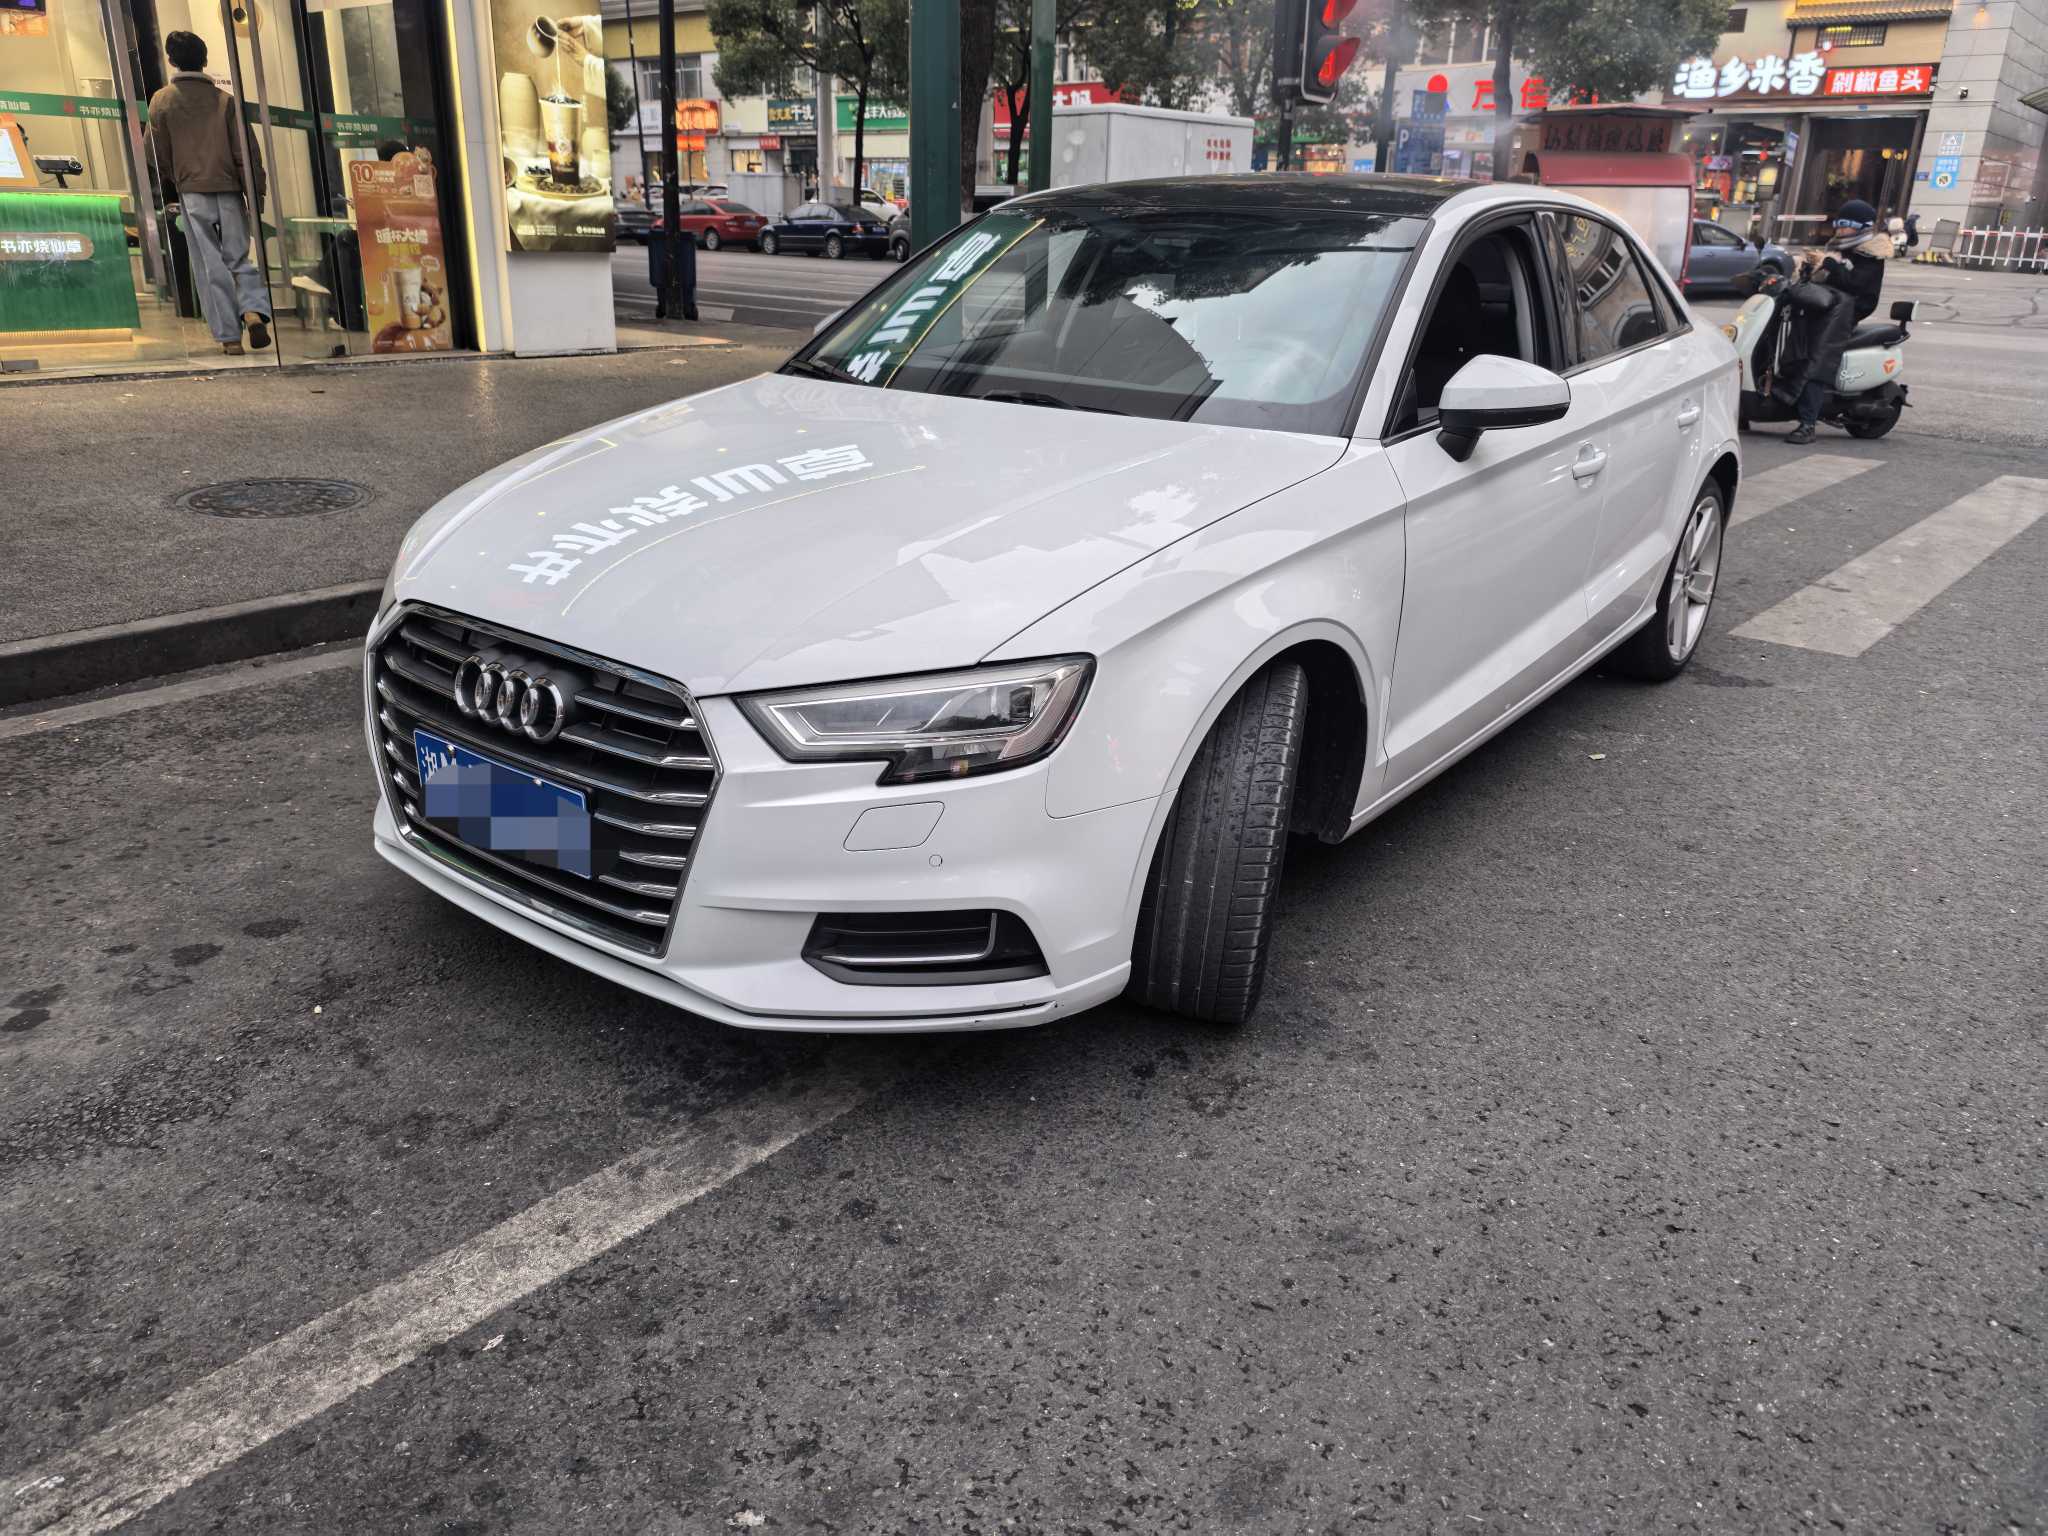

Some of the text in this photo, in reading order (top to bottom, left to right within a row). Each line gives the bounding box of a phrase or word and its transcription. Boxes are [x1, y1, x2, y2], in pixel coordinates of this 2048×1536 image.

[1673, 51, 1826, 98] 渔乡米香
[1831, 70, 1923, 94] 剁椒鱼头
[0, 239, 82, 254] 书亦烧仙草
